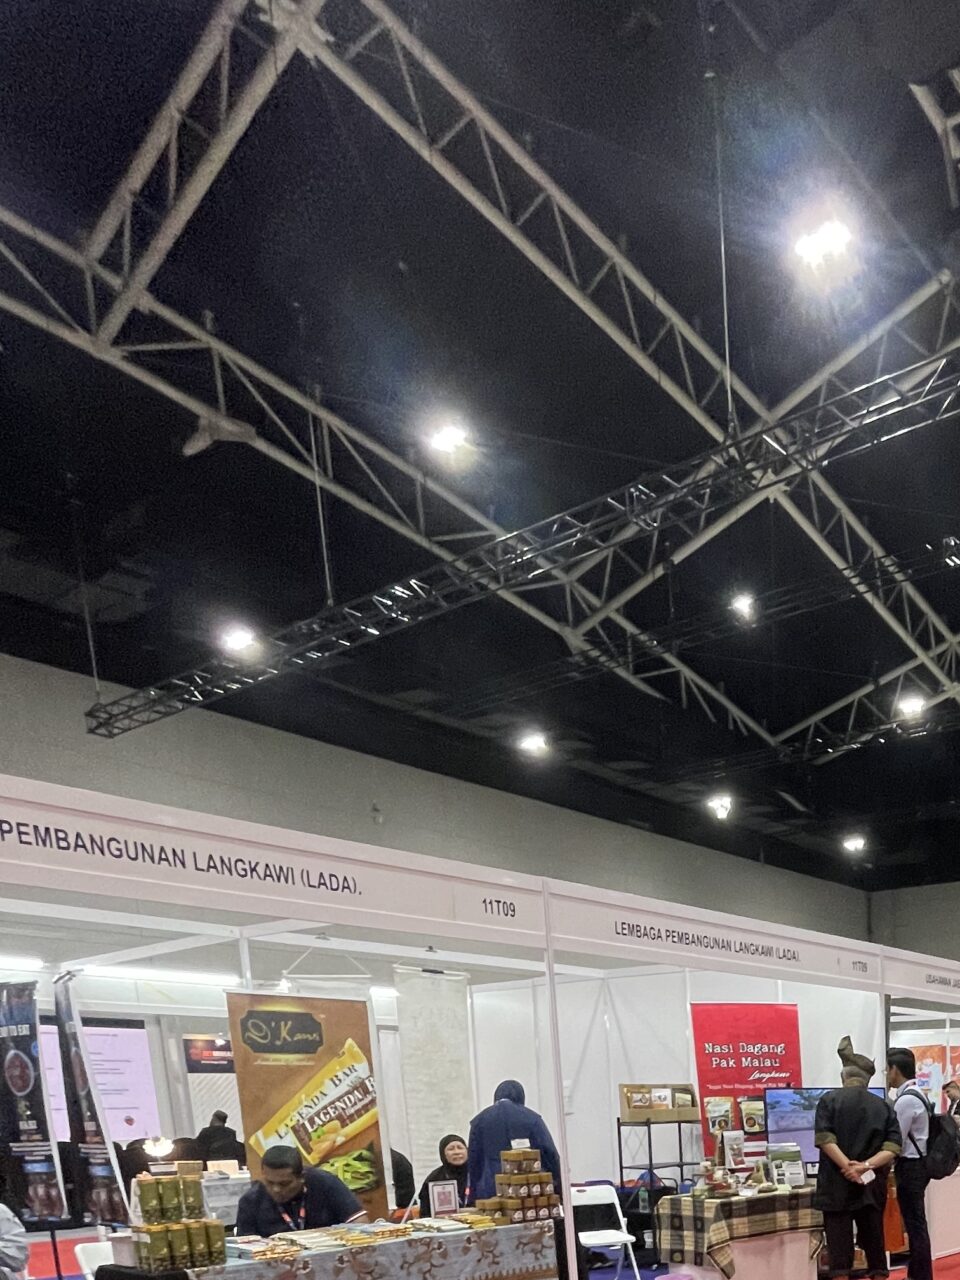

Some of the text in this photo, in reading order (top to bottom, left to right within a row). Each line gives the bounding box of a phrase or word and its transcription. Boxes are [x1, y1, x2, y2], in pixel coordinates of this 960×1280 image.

[0, 820, 362, 896] PEMBANGUNAN LANGKAWI (LADA).
[482, 898, 516, 918] 11T09
[614, 921, 663, 941] LEMBAGA
[665, 931, 732, 953] PEMBANGUNAN
[734, 941, 774, 959] LANGKAWI
[704, 1042, 786, 1055] Nasi Dagang
[712, 1057, 780, 1067] Pak Malau
[329, 1064, 359, 1088] BAR
[303, 1089, 363, 1133] LAGENDA
